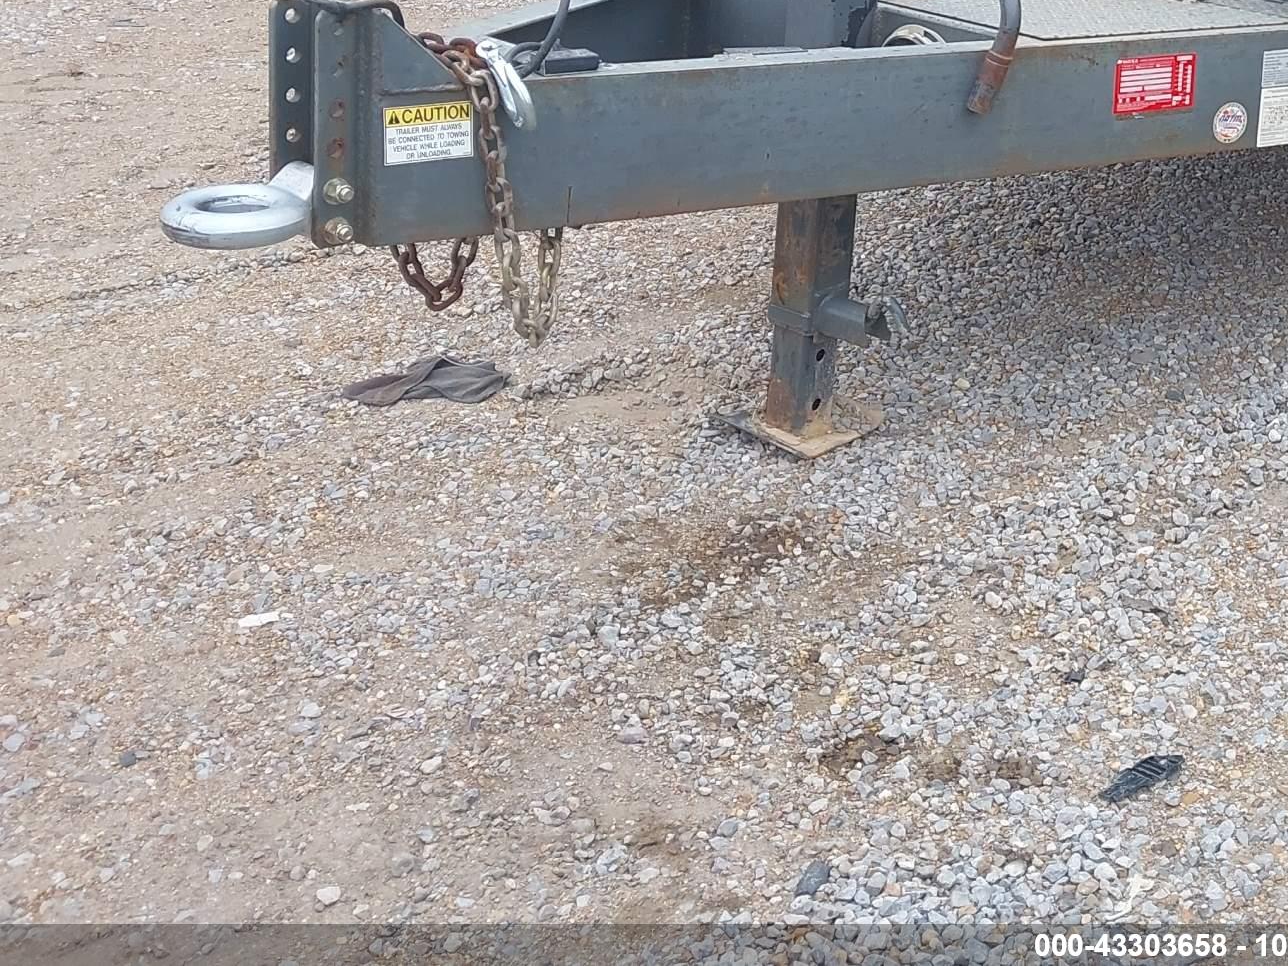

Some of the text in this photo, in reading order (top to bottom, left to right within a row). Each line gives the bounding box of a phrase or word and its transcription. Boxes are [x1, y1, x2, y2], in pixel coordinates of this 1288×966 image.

[402, 105, 469, 124] CAUTION
[395, 123, 462, 136] TRAILER MUST ALWAYS
[399, 135, 435, 143] CONNECTED
[447, 131, 469, 139] TOWING
[393, 139, 465, 153] VEHICLE WHILE LOADING
[406, 152, 415, 160] OR
